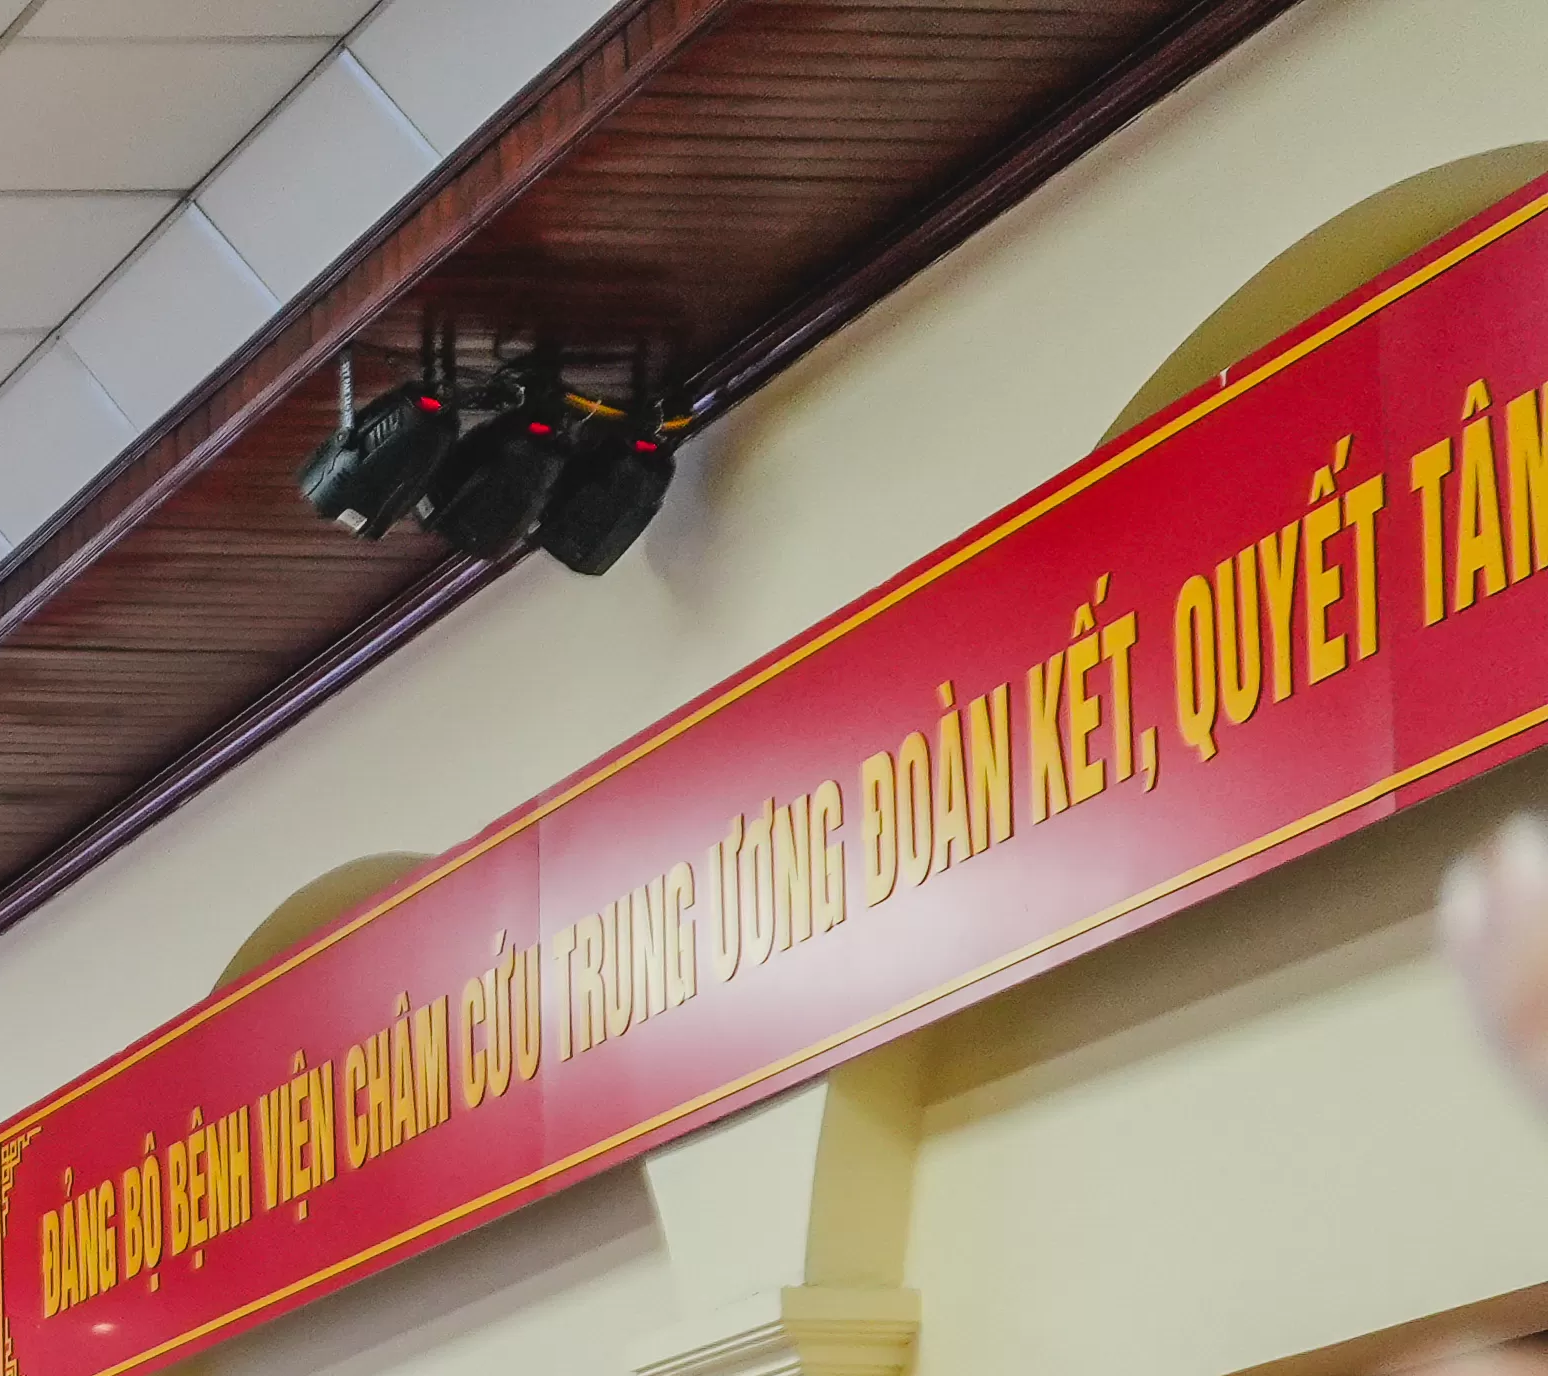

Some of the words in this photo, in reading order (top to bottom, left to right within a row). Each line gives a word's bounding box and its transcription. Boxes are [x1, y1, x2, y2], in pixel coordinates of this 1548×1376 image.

[40, 1165, 117, 1319] ĐẢNG
[122, 1132, 161, 1292] BỘ
[167, 1106, 252, 1269] BỆNH
[260, 1049, 336, 1220] VIỆN
[345, 991, 451, 1170] CHÂM
[461, 930, 542, 1109] CỨU
[553, 861, 697, 1062] TRUNG
[707, 779, 846, 984] ƯƠNG
[861, 680, 1014, 908] ĐOÀN
[1028, 572, 1158, 826] KẾT,
[1173, 434, 1388, 763] QUYẾT
